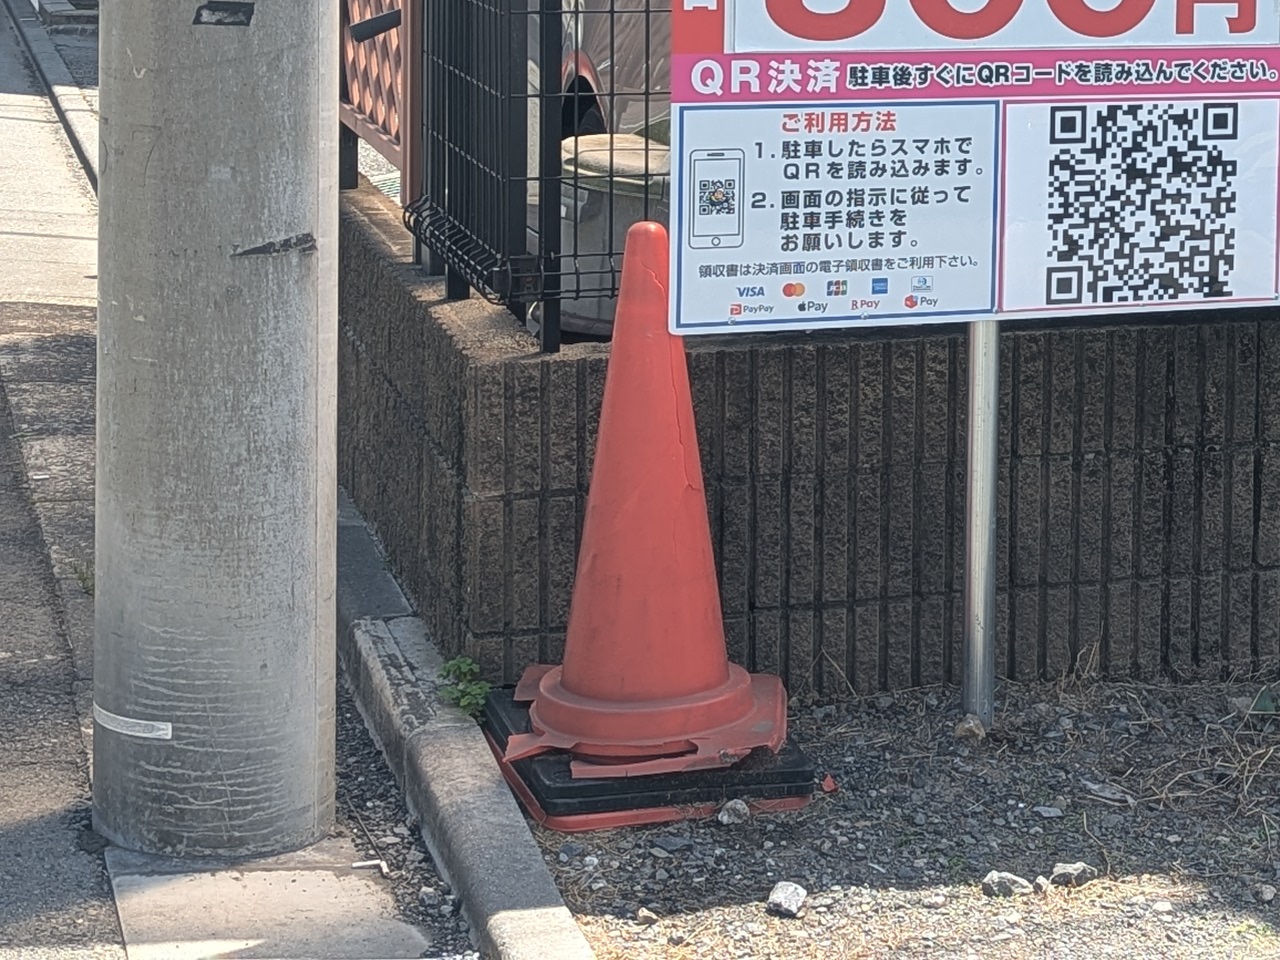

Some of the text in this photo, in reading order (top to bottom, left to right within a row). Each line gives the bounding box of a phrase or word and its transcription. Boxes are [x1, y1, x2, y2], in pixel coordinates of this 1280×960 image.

[691, 59, 841, 95] QR決済
[847, 59, 1278, 88] 駐車後すぐにQRコードを読み込んでください。
[782, 111, 896, 133] ご利用方法
[783, 158, 983, 180] QRを読み込みます。
[780, 208, 908, 231] 駐車手続きを
[780, 230, 918, 253] お願いします。
[698, 255, 979, 278] 領収書は決済画面の電子領収書をご利用下さい。
[736, 286, 765, 298] VISA
[920, 296, 938, 308] Pay
[743, 304, 774, 314] PayPay
[807, 301, 829, 313] Pay
[860, 299, 880, 310] Pay
